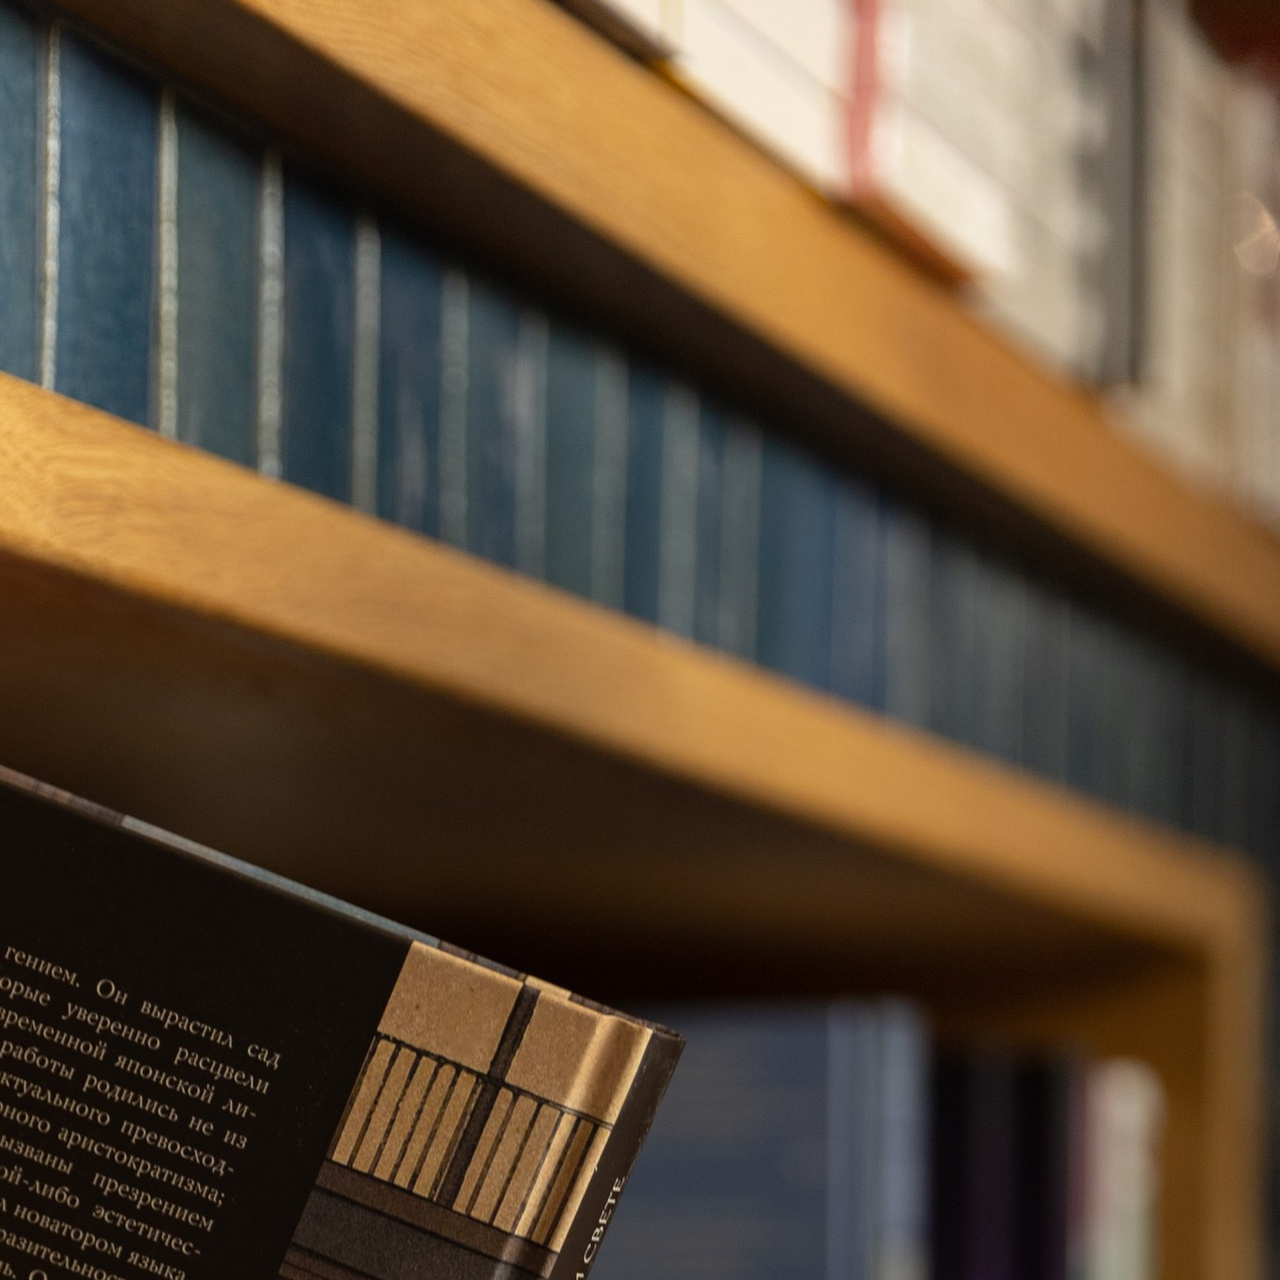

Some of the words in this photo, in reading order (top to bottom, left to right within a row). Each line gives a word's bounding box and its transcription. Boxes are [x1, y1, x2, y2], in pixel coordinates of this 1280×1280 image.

[4, 946, 79, 987] гением.
[96, 978, 127, 1005] Он
[140, 1000, 232, 1048] вырастил
[247, 1044, 280, 1070] сад
[61, 1002, 160, 1049] уверенно
[173, 1046, 269, 1094] расцвели
[82, 1073, 177, 1121] родились
[188, 1115, 213, 1135] не
[223, 1129, 247, 1148] из
[114, 1055, 214, 1103] японской
[221, 1098, 256, 1117] ли-
[57, 1127, 224, 1207] аристократизма;
[120, 1120, 233, 1176] превосход-
[13, 1203, 122, 1258] новатором
[92, 1172, 213, 1231] презрением
[92, 1204, 200, 1255] эстетичес-
[583, 1177, 625, 1263] СВЕТЕ
